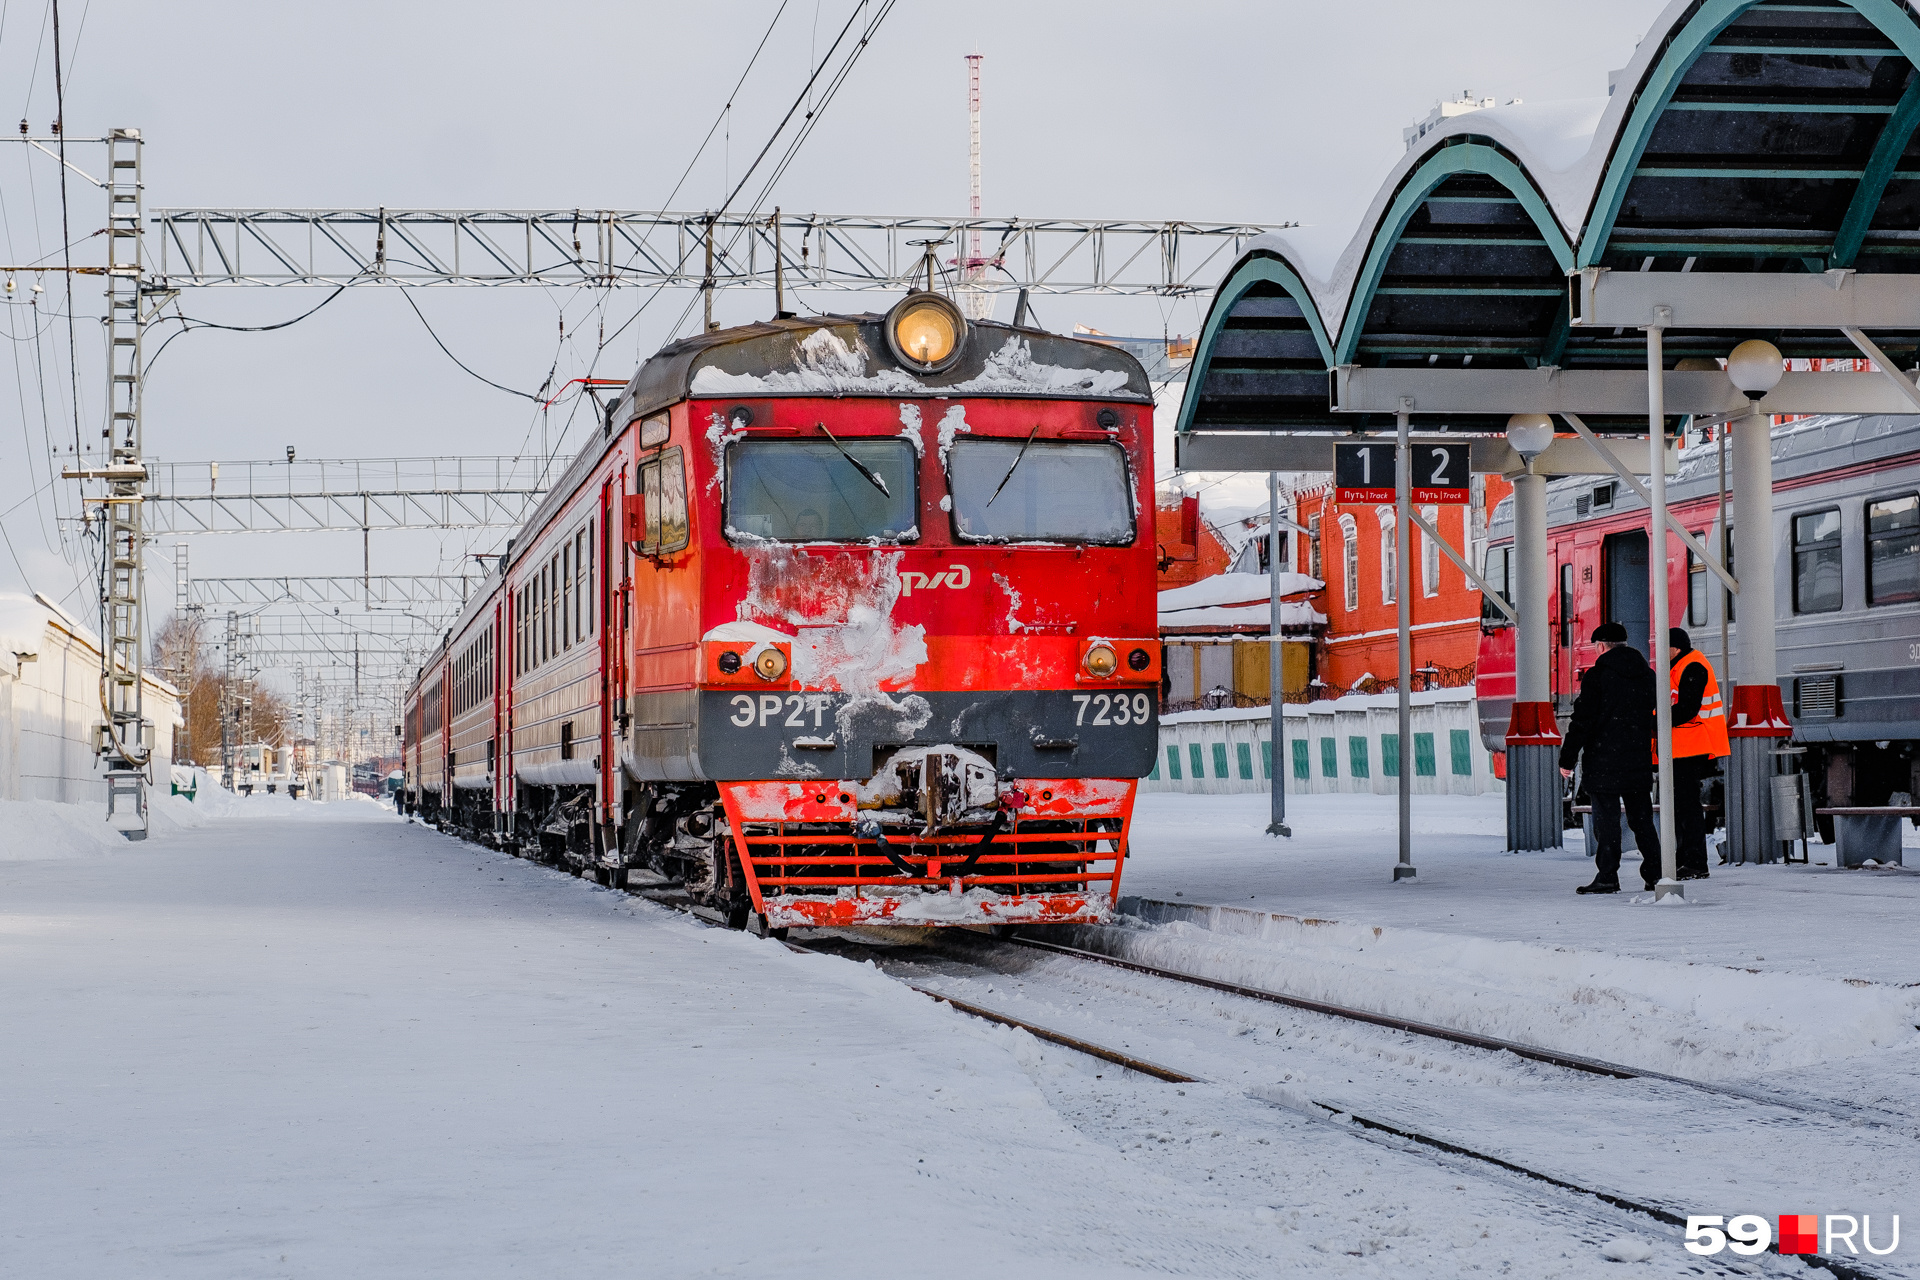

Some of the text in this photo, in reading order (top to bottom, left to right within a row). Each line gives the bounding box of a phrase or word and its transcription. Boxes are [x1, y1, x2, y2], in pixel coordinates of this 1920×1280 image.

[1356, 447, 1371, 484] 1
[1430, 447, 1450, 485] 2
[1344, 490, 1389, 501] Путь Track
[1419, 490, 1462, 501] Путь Track
[1072, 693, 1150, 726] 7239
